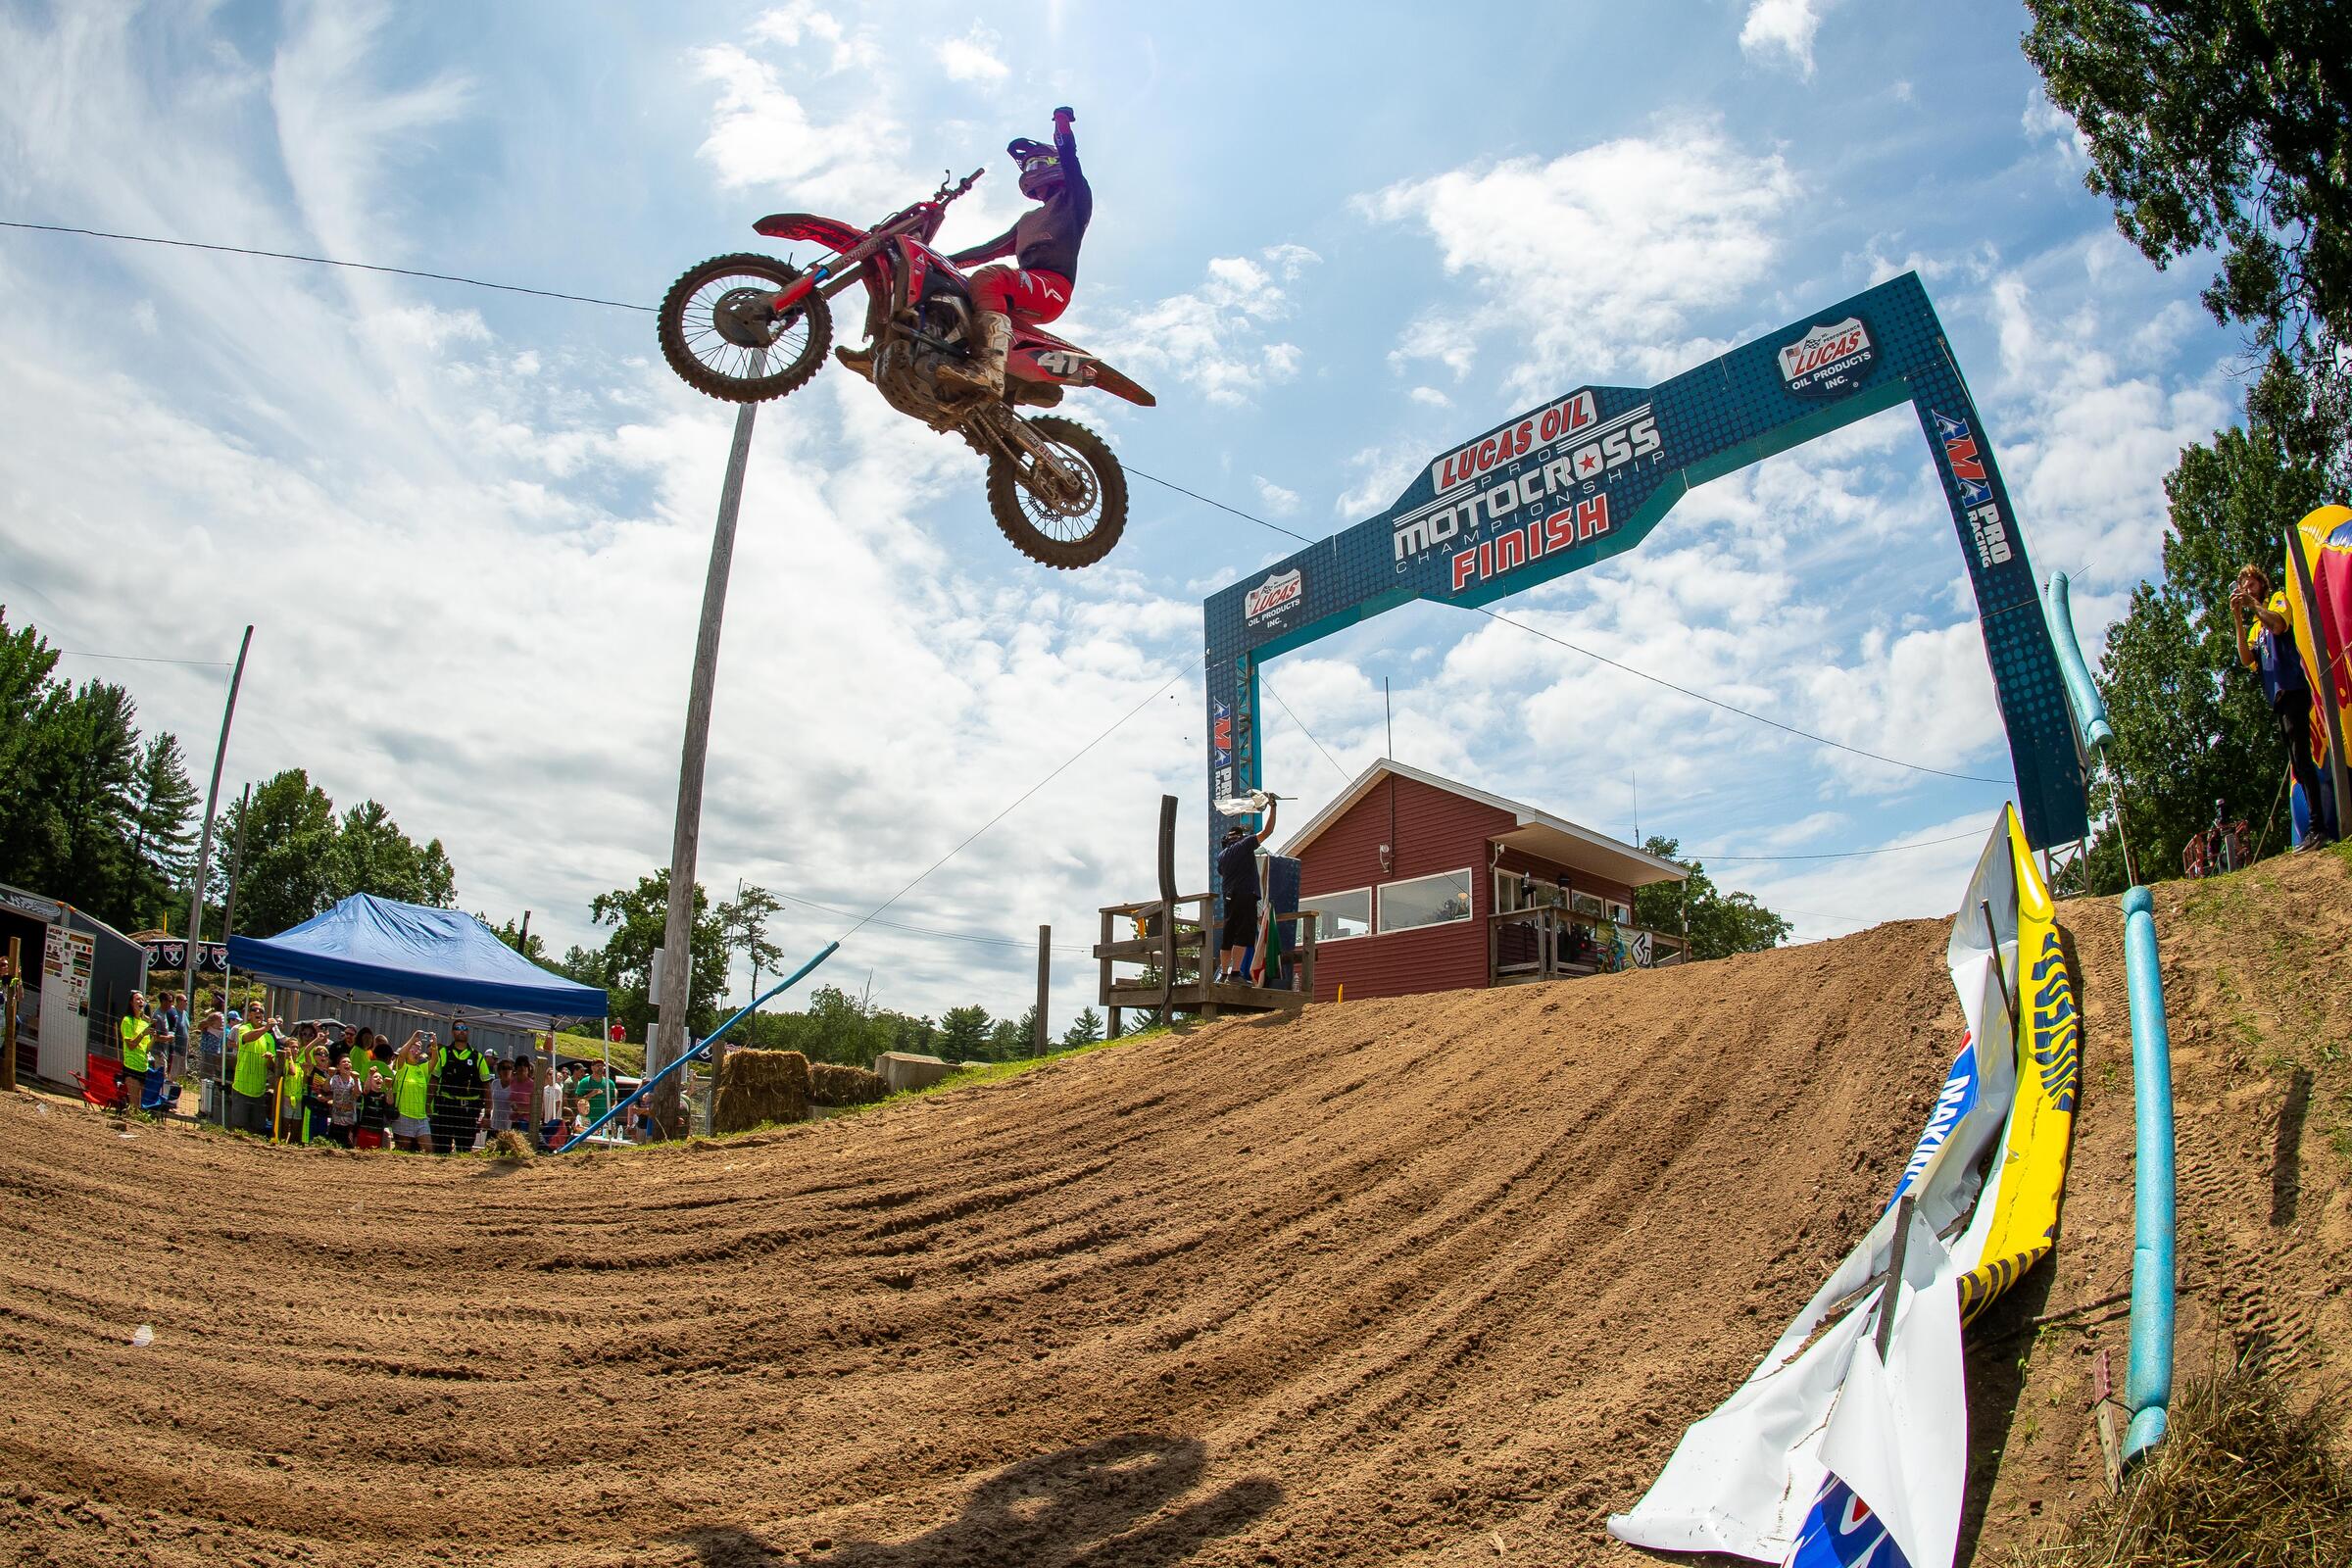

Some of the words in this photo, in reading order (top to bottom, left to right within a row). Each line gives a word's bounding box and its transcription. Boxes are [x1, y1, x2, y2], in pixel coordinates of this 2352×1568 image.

[1038, 350, 1079, 374] 41
[1791, 378, 1812, 390] OIL
[1813, 351, 1872, 381] PRODUCTS
[1793, 331, 1861, 376] LUCAS
[1825, 375, 1848, 389] INC.
[1441, 421, 1534, 489] LUCAS
[1541, 396, 1589, 441] OIL
[1932, 409, 1993, 509] AMA
[1393, 416, 1661, 562] MOTOCROSS
[1481, 449, 1551, 488] PRO
[1396, 451, 1665, 573] CHAMPIONSHIP
[1978, 503, 2012, 564] PRO
[1451, 492, 1609, 591] FINISH
[1967, 510, 1992, 568] RACING
[1250, 580, 1299, 615] LUCAS
[1261, 599, 1300, 621] PRODUCTS
[1267, 617, 1282, 628] INC.
[1213, 696, 1232, 768] AMA
